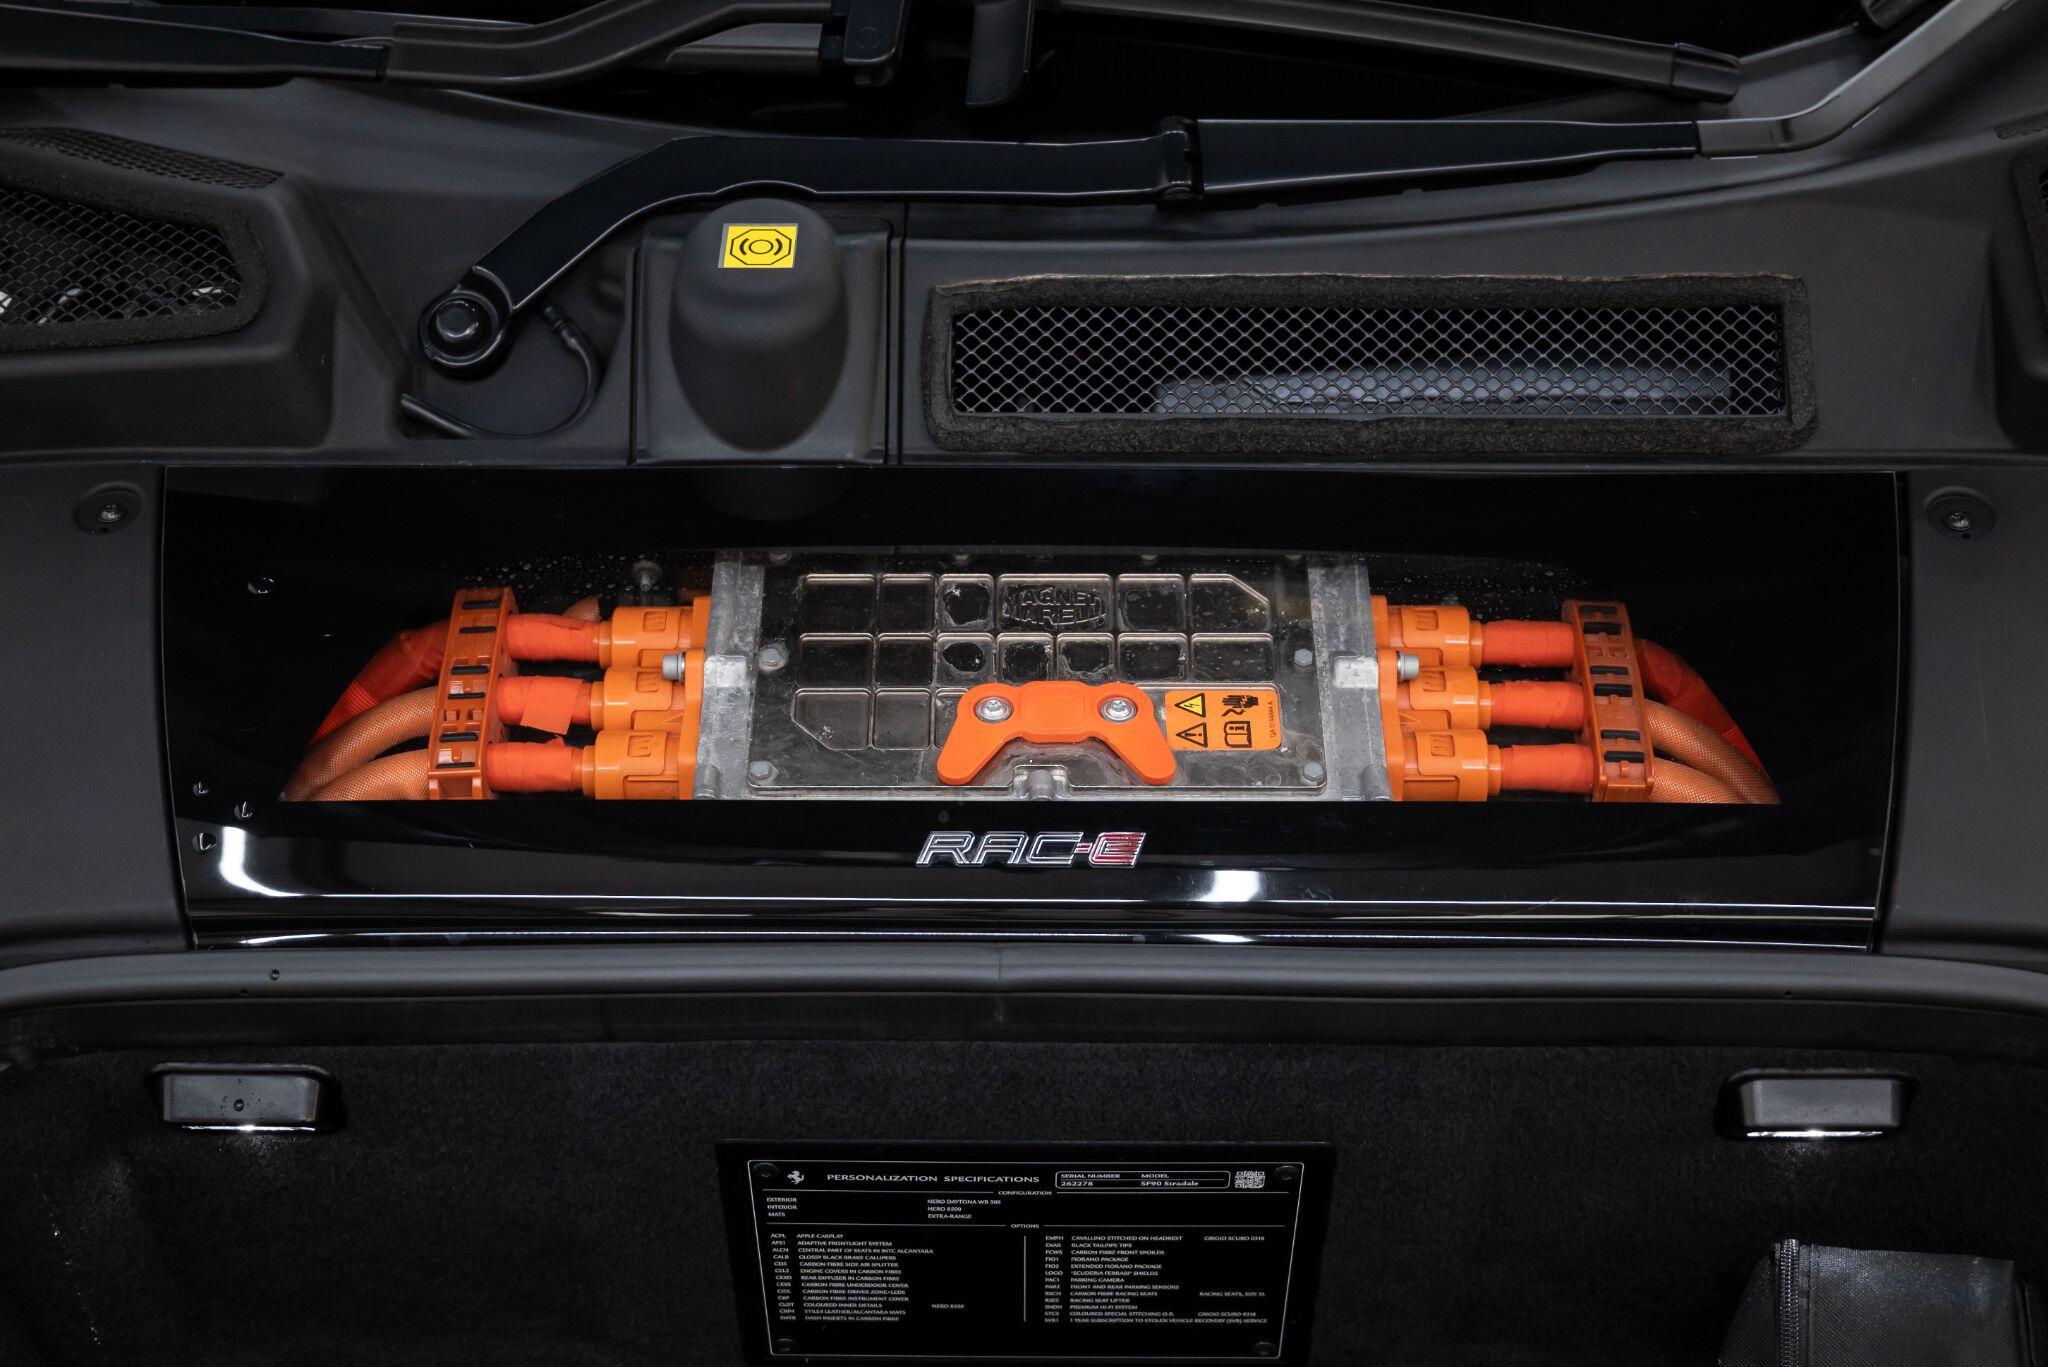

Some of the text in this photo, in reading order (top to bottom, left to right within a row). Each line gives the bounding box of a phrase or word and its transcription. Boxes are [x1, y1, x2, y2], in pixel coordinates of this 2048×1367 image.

[915, 831, 1146, 868] RAC-E
[827, 1174, 1040, 1183] PERSONALIZATION SPECIFICATIONS
